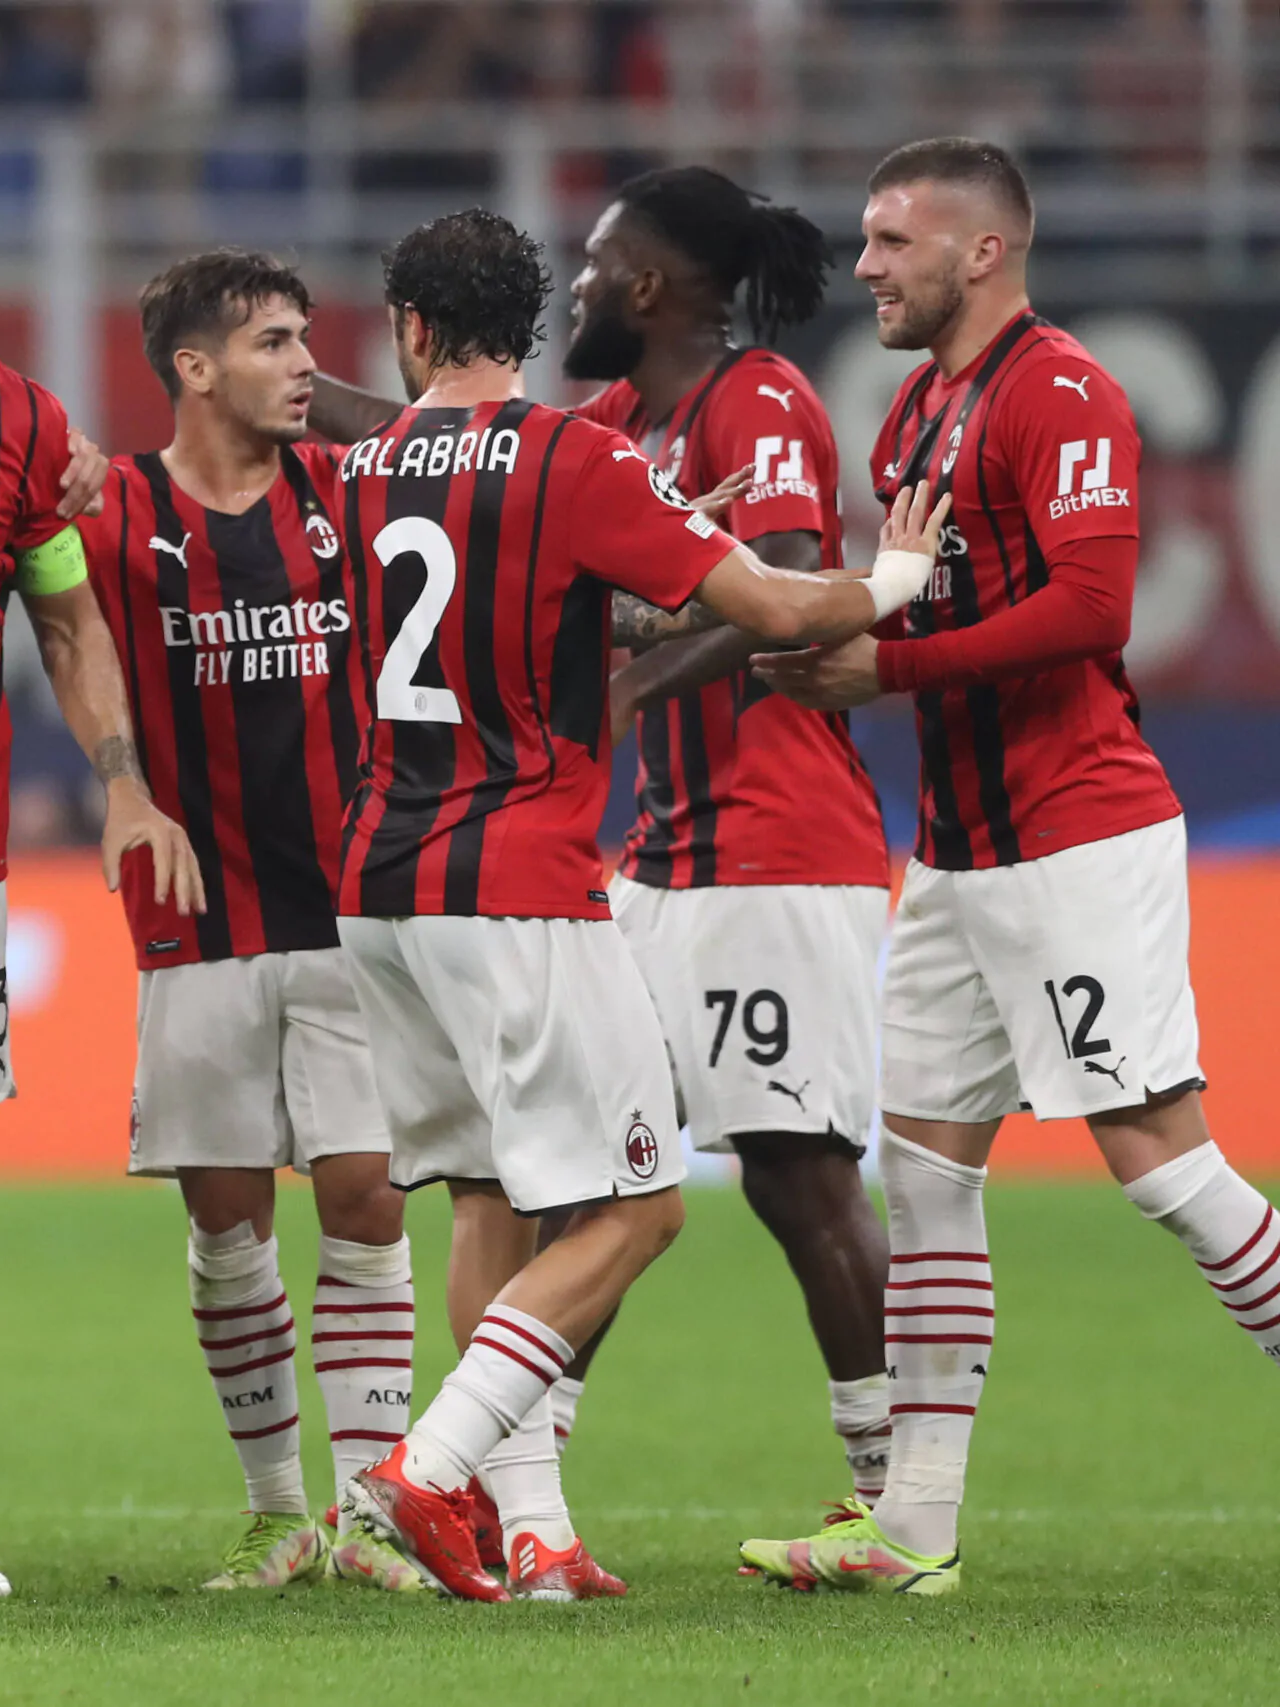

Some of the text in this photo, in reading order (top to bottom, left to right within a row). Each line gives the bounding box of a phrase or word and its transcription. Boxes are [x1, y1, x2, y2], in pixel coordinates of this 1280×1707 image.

[340, 427, 521, 483] CALABRIA
[1048, 487, 1130, 520] BitMEX
[158, 597, 351, 647] Emirates
[371, 516, 463, 725] 2
[193, 641, 329, 687] FLY BETTER
[705, 989, 789, 1068] 79
[1044, 974, 1111, 1059] 12
[223, 1385, 274, 1409] ACM
[364, 1389, 412, 1407] ACM
